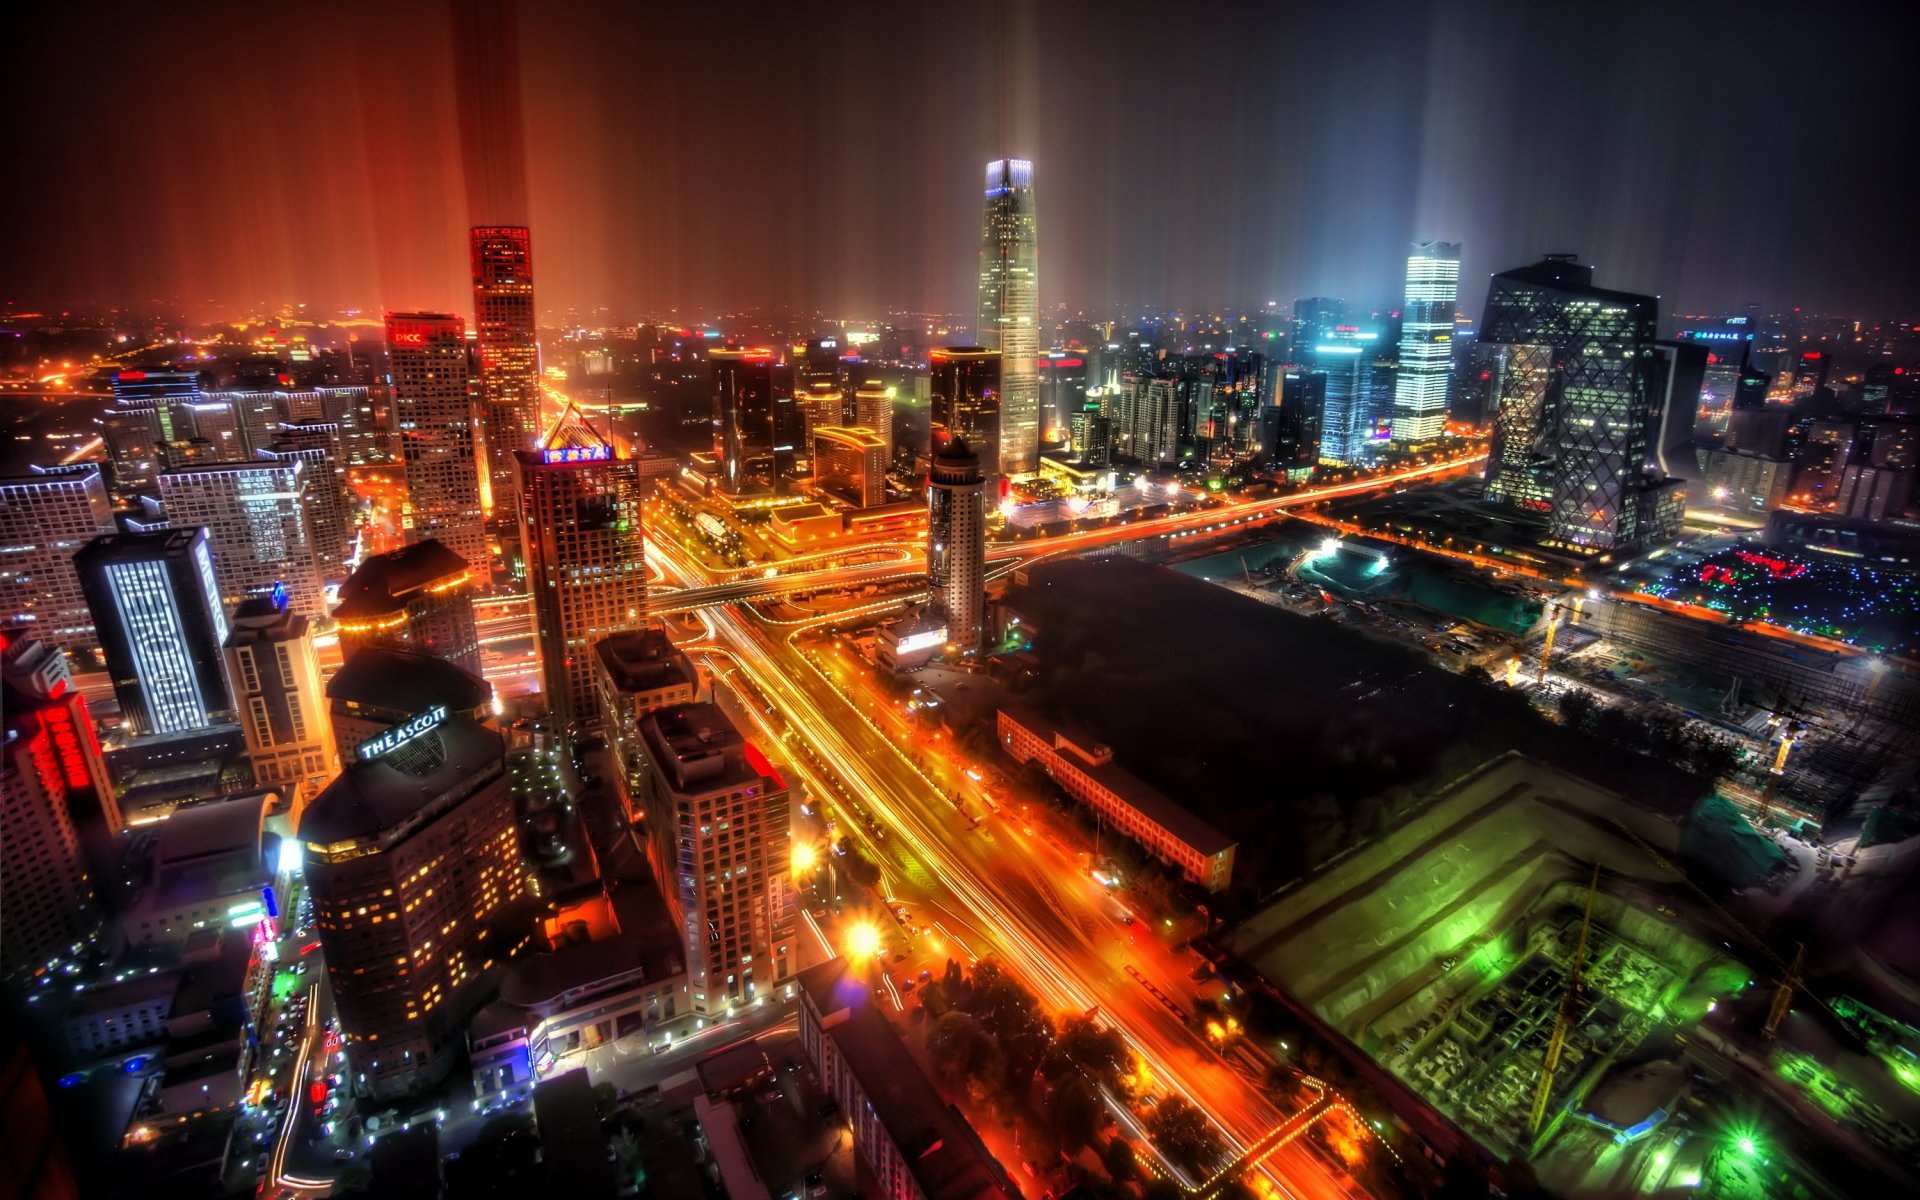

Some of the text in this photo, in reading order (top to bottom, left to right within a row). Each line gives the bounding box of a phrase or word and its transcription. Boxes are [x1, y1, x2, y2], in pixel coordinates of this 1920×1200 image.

[396, 333, 421, 342] PICC
[116, 567, 201, 727] METROPOLIS
[362, 706, 446, 759] THE ASCOTT
